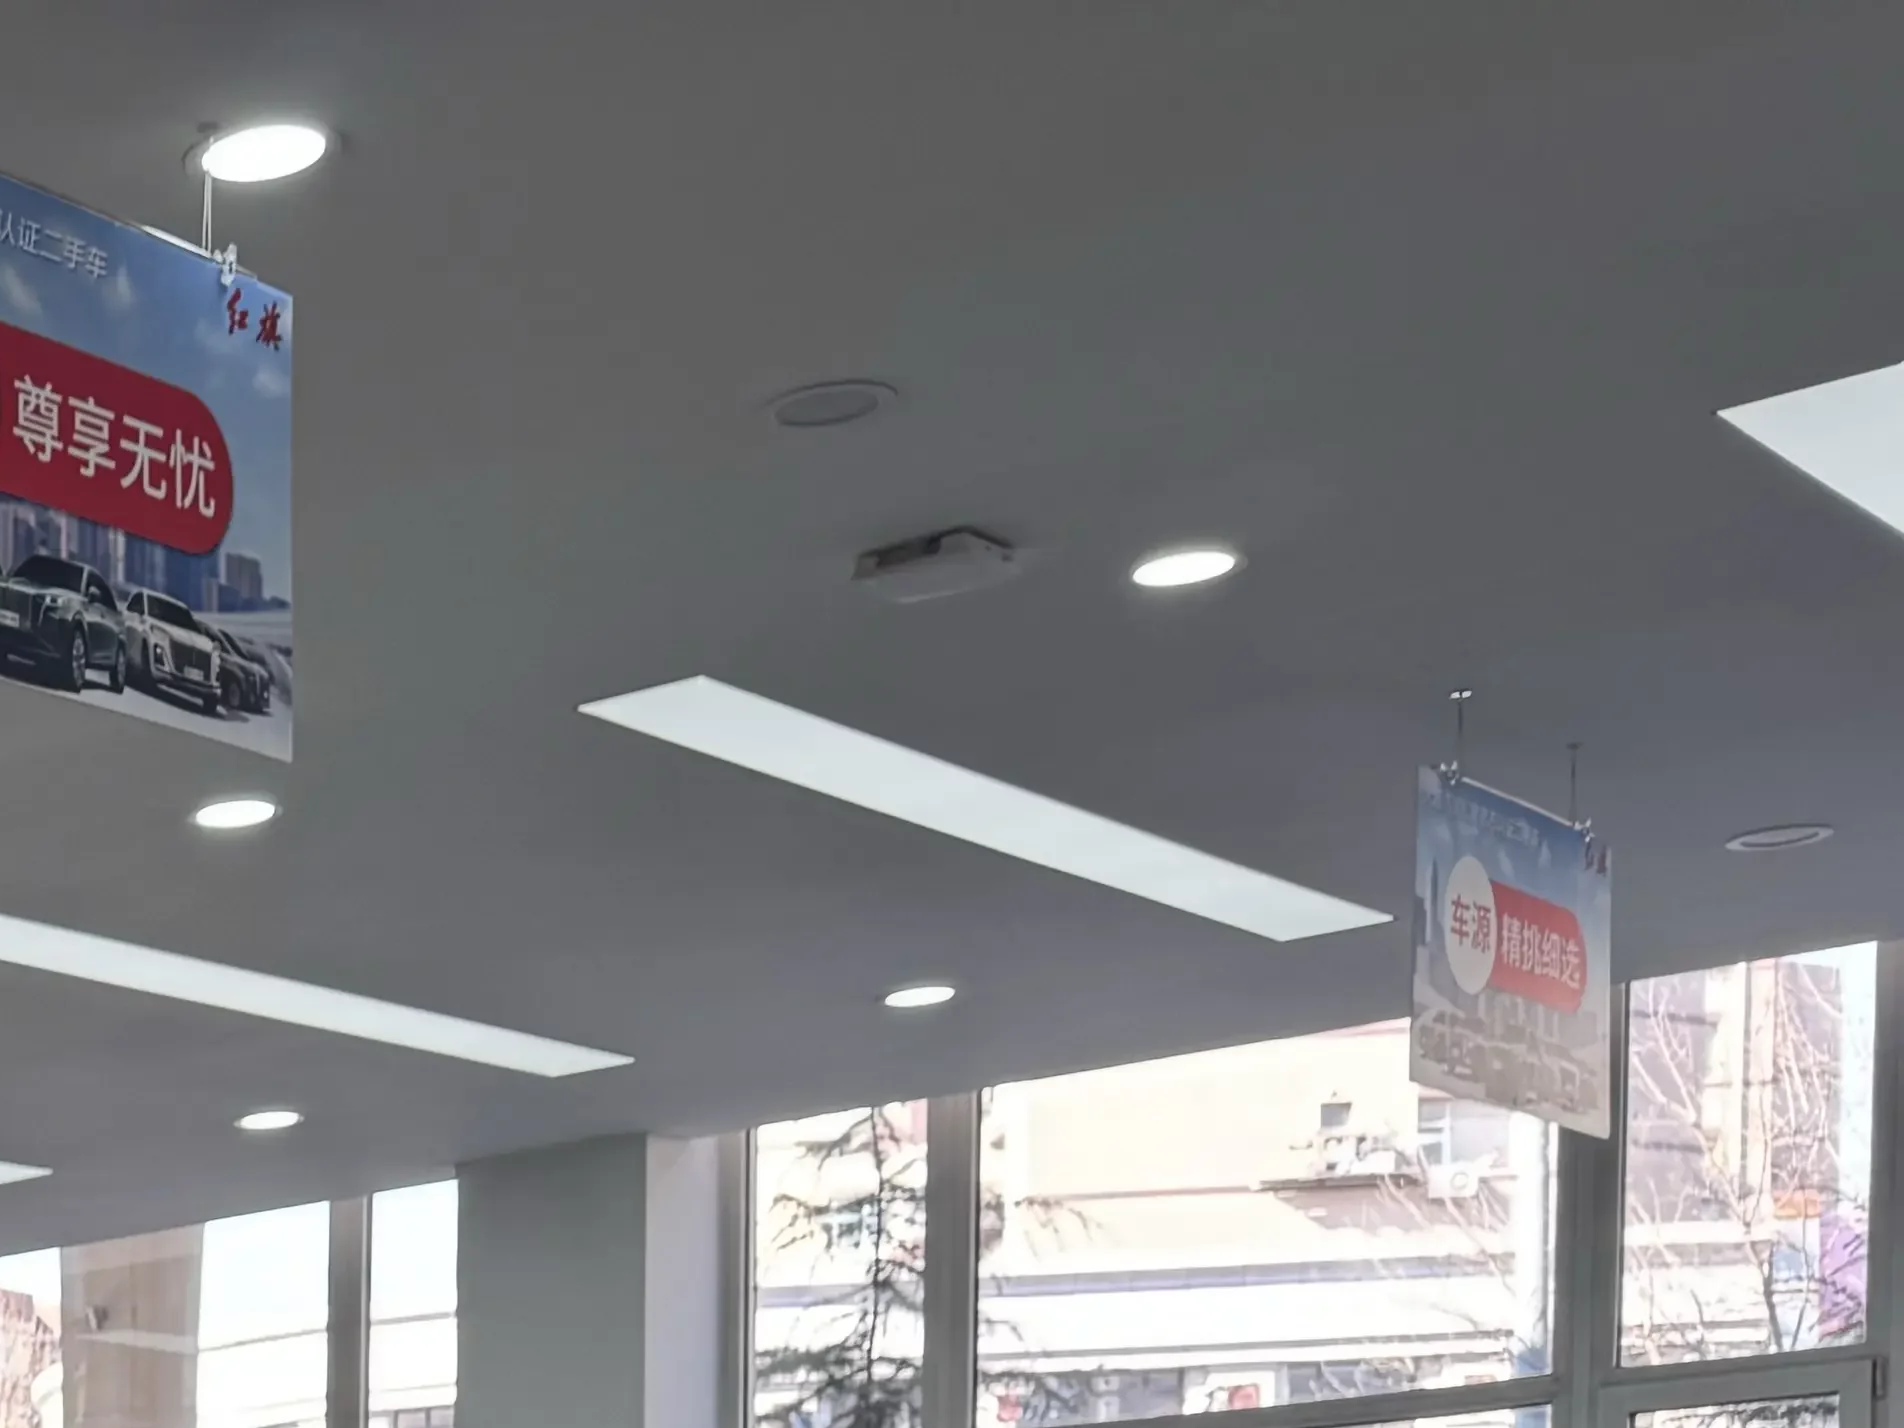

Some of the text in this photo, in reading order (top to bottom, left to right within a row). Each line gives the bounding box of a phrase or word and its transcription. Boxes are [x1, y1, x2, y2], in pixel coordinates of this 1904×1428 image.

[226, 288, 283, 351] 红旗
[12, 375, 217, 519] 尊享无忧
[1450, 894, 1582, 990] 车源 精挑细选
